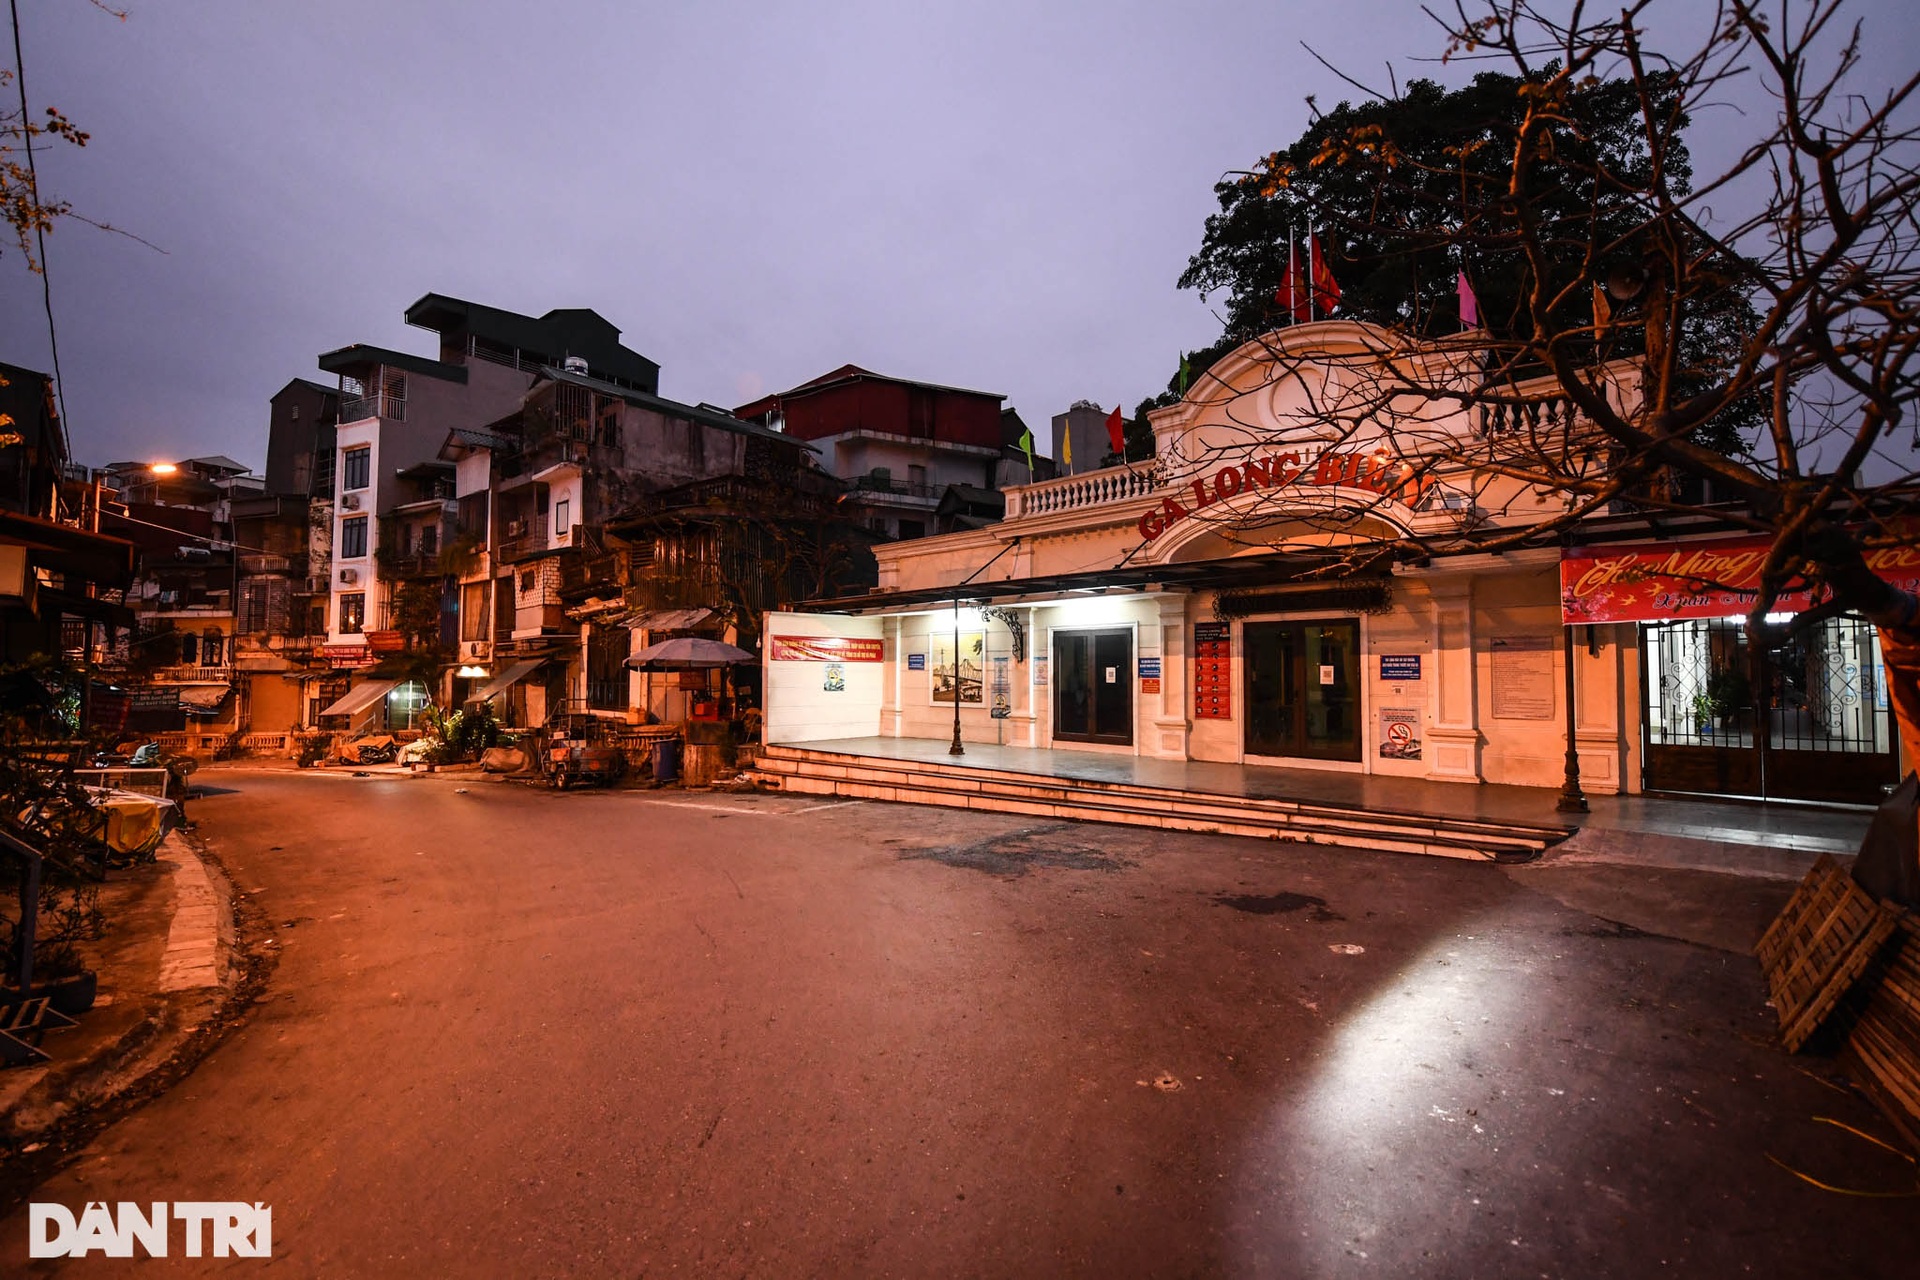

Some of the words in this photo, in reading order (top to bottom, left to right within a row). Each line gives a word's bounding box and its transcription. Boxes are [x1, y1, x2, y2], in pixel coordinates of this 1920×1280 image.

[1138, 497, 1189, 541] GA
[1190, 452, 1301, 510] LONG
[1312, 446, 1437, 509] BIÊN
